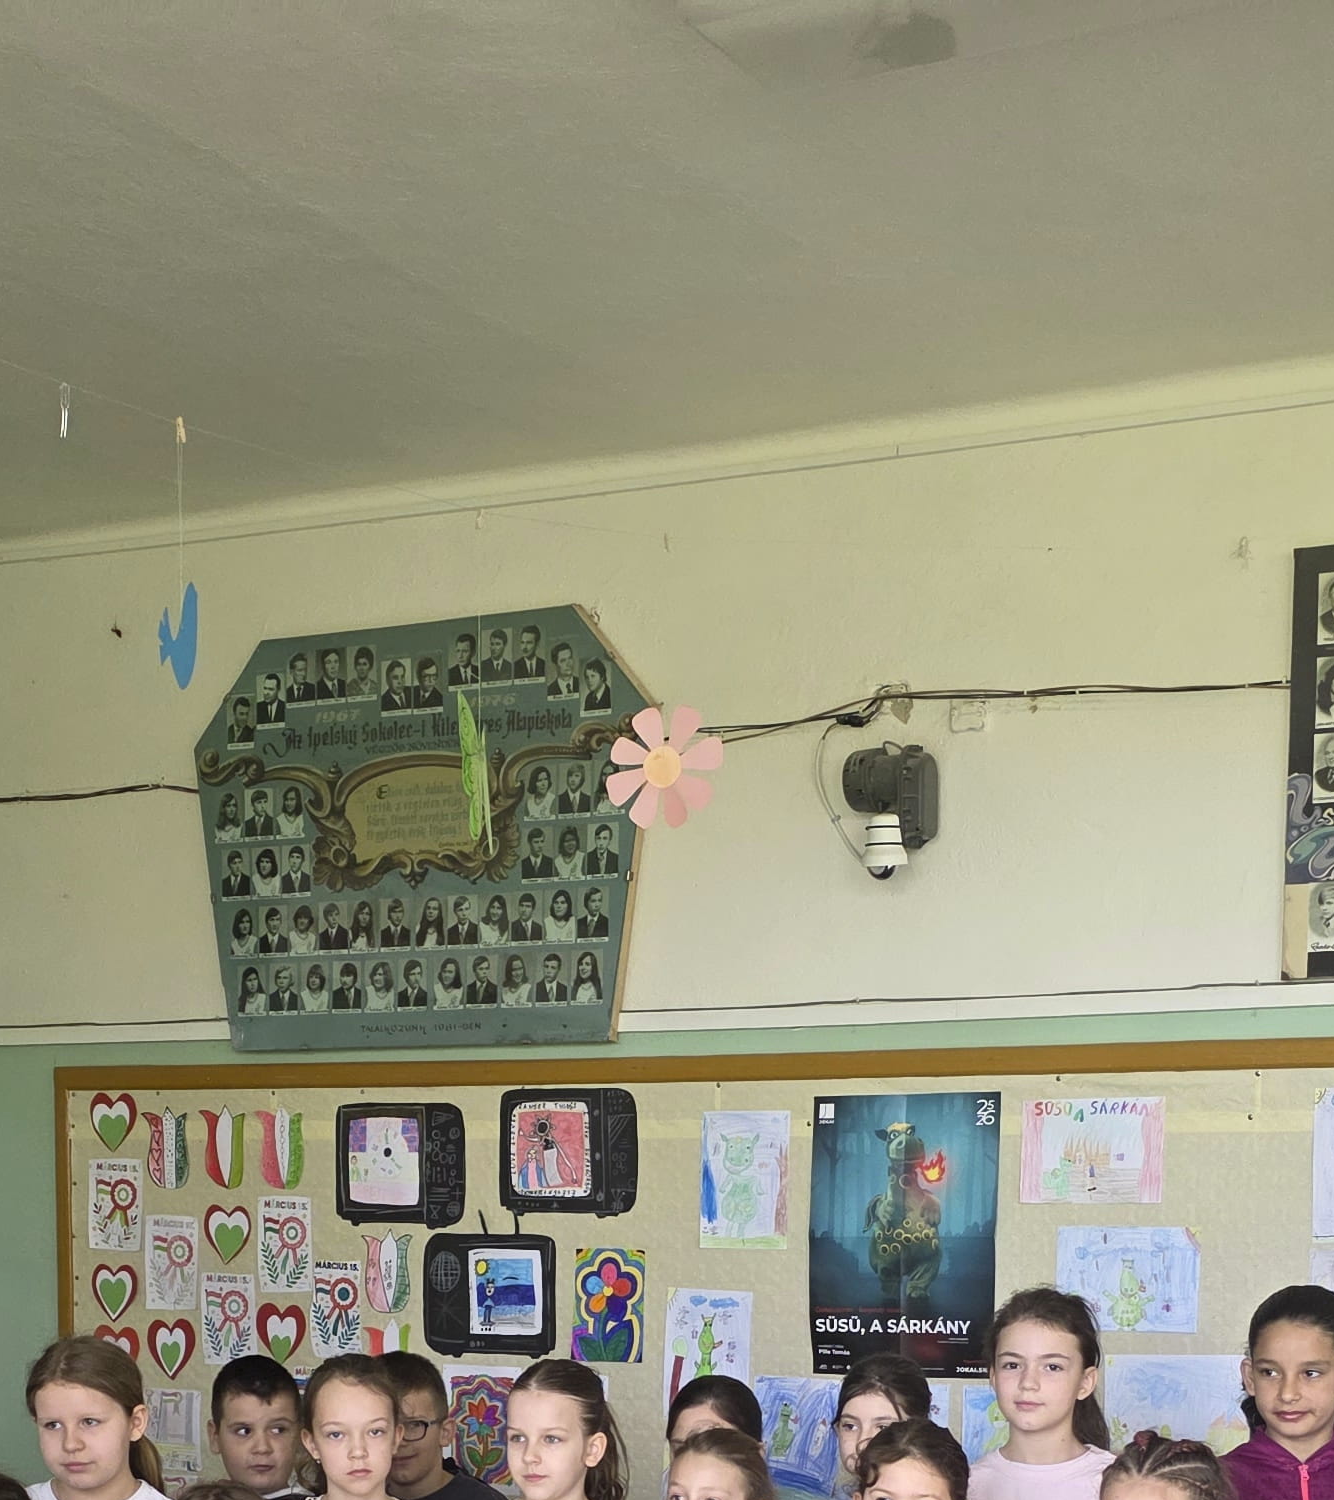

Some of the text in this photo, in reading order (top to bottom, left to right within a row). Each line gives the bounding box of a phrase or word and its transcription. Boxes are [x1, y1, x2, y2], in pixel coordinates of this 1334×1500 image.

[315, 1260, 348, 1271] MÁRCIUS
[870, 1319, 884, 1333] A
[887, 1316, 971, 1335] SÁRKÁNY
